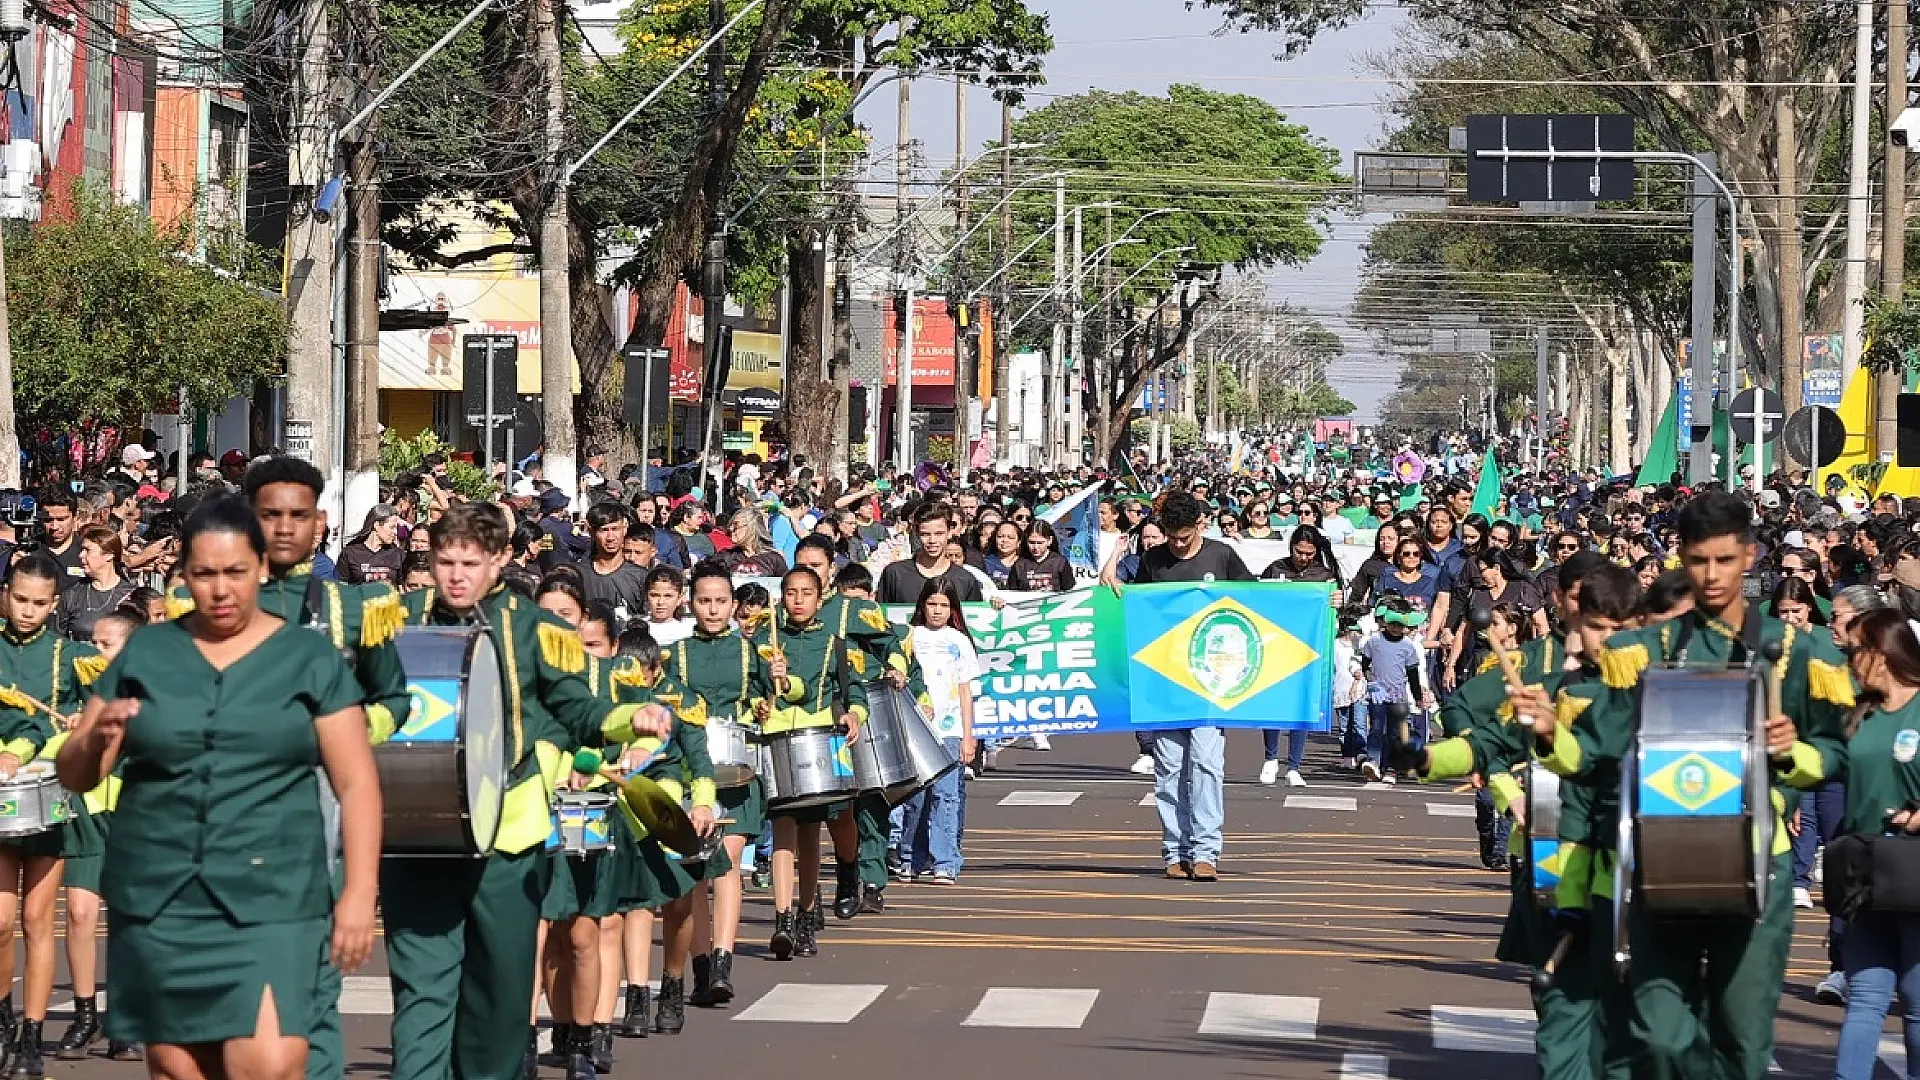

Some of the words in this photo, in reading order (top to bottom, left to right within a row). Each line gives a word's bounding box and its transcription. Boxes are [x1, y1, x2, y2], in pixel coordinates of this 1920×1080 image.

[992, 671, 1097, 695] UMA
[973, 694, 1099, 724] ÊNCIA
[1002, 721, 1099, 734] KASPAROV
